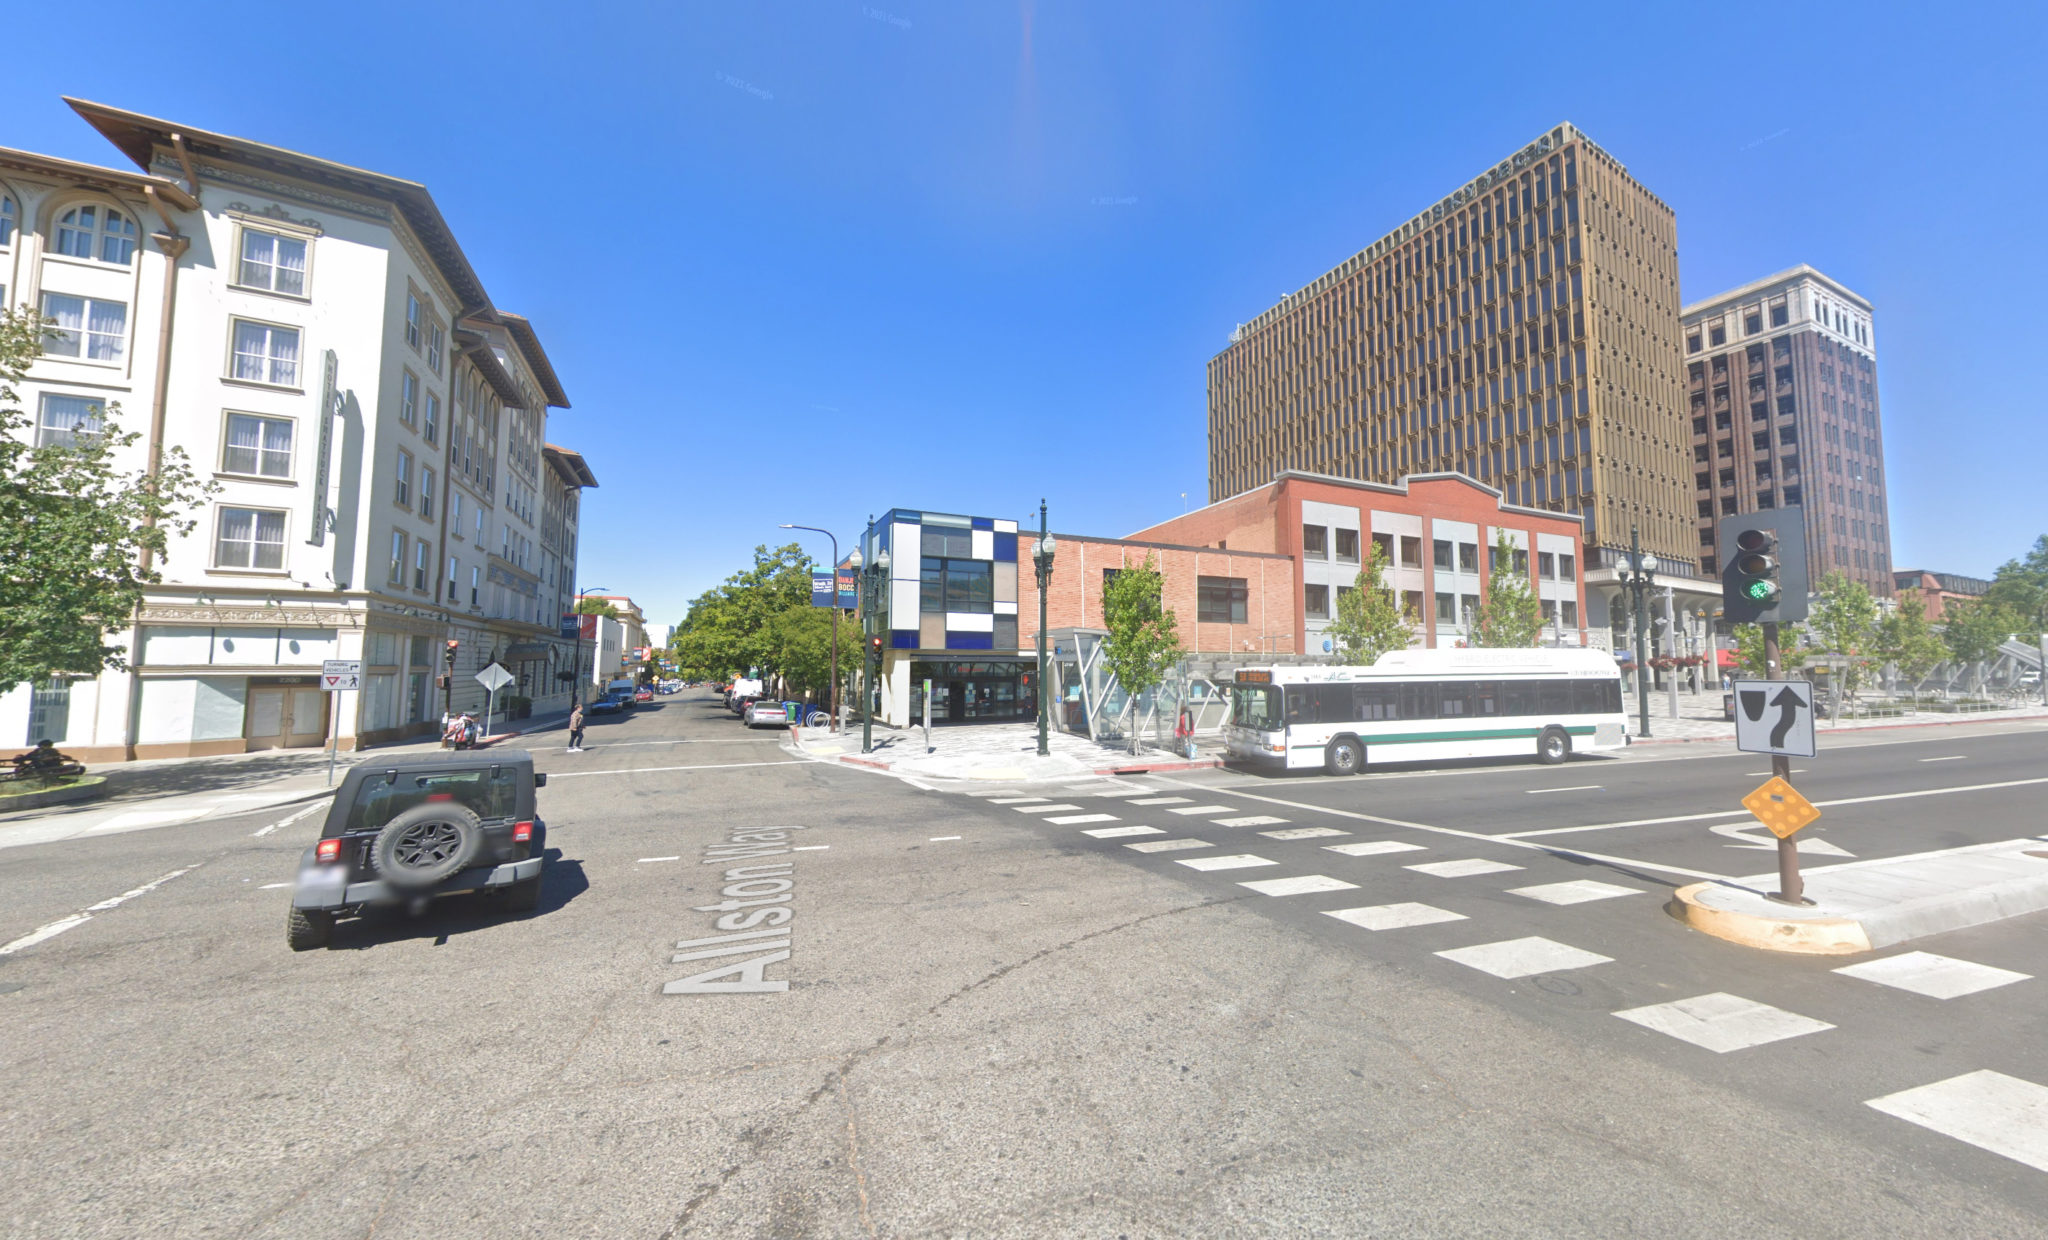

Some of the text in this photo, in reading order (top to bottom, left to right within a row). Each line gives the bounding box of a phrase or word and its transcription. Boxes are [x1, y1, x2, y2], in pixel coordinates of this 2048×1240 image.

[325, 364, 334, 408] HOTEL
[314, 494, 323, 538] PLAZA
[662, 825, 811, 995] Allston Way
